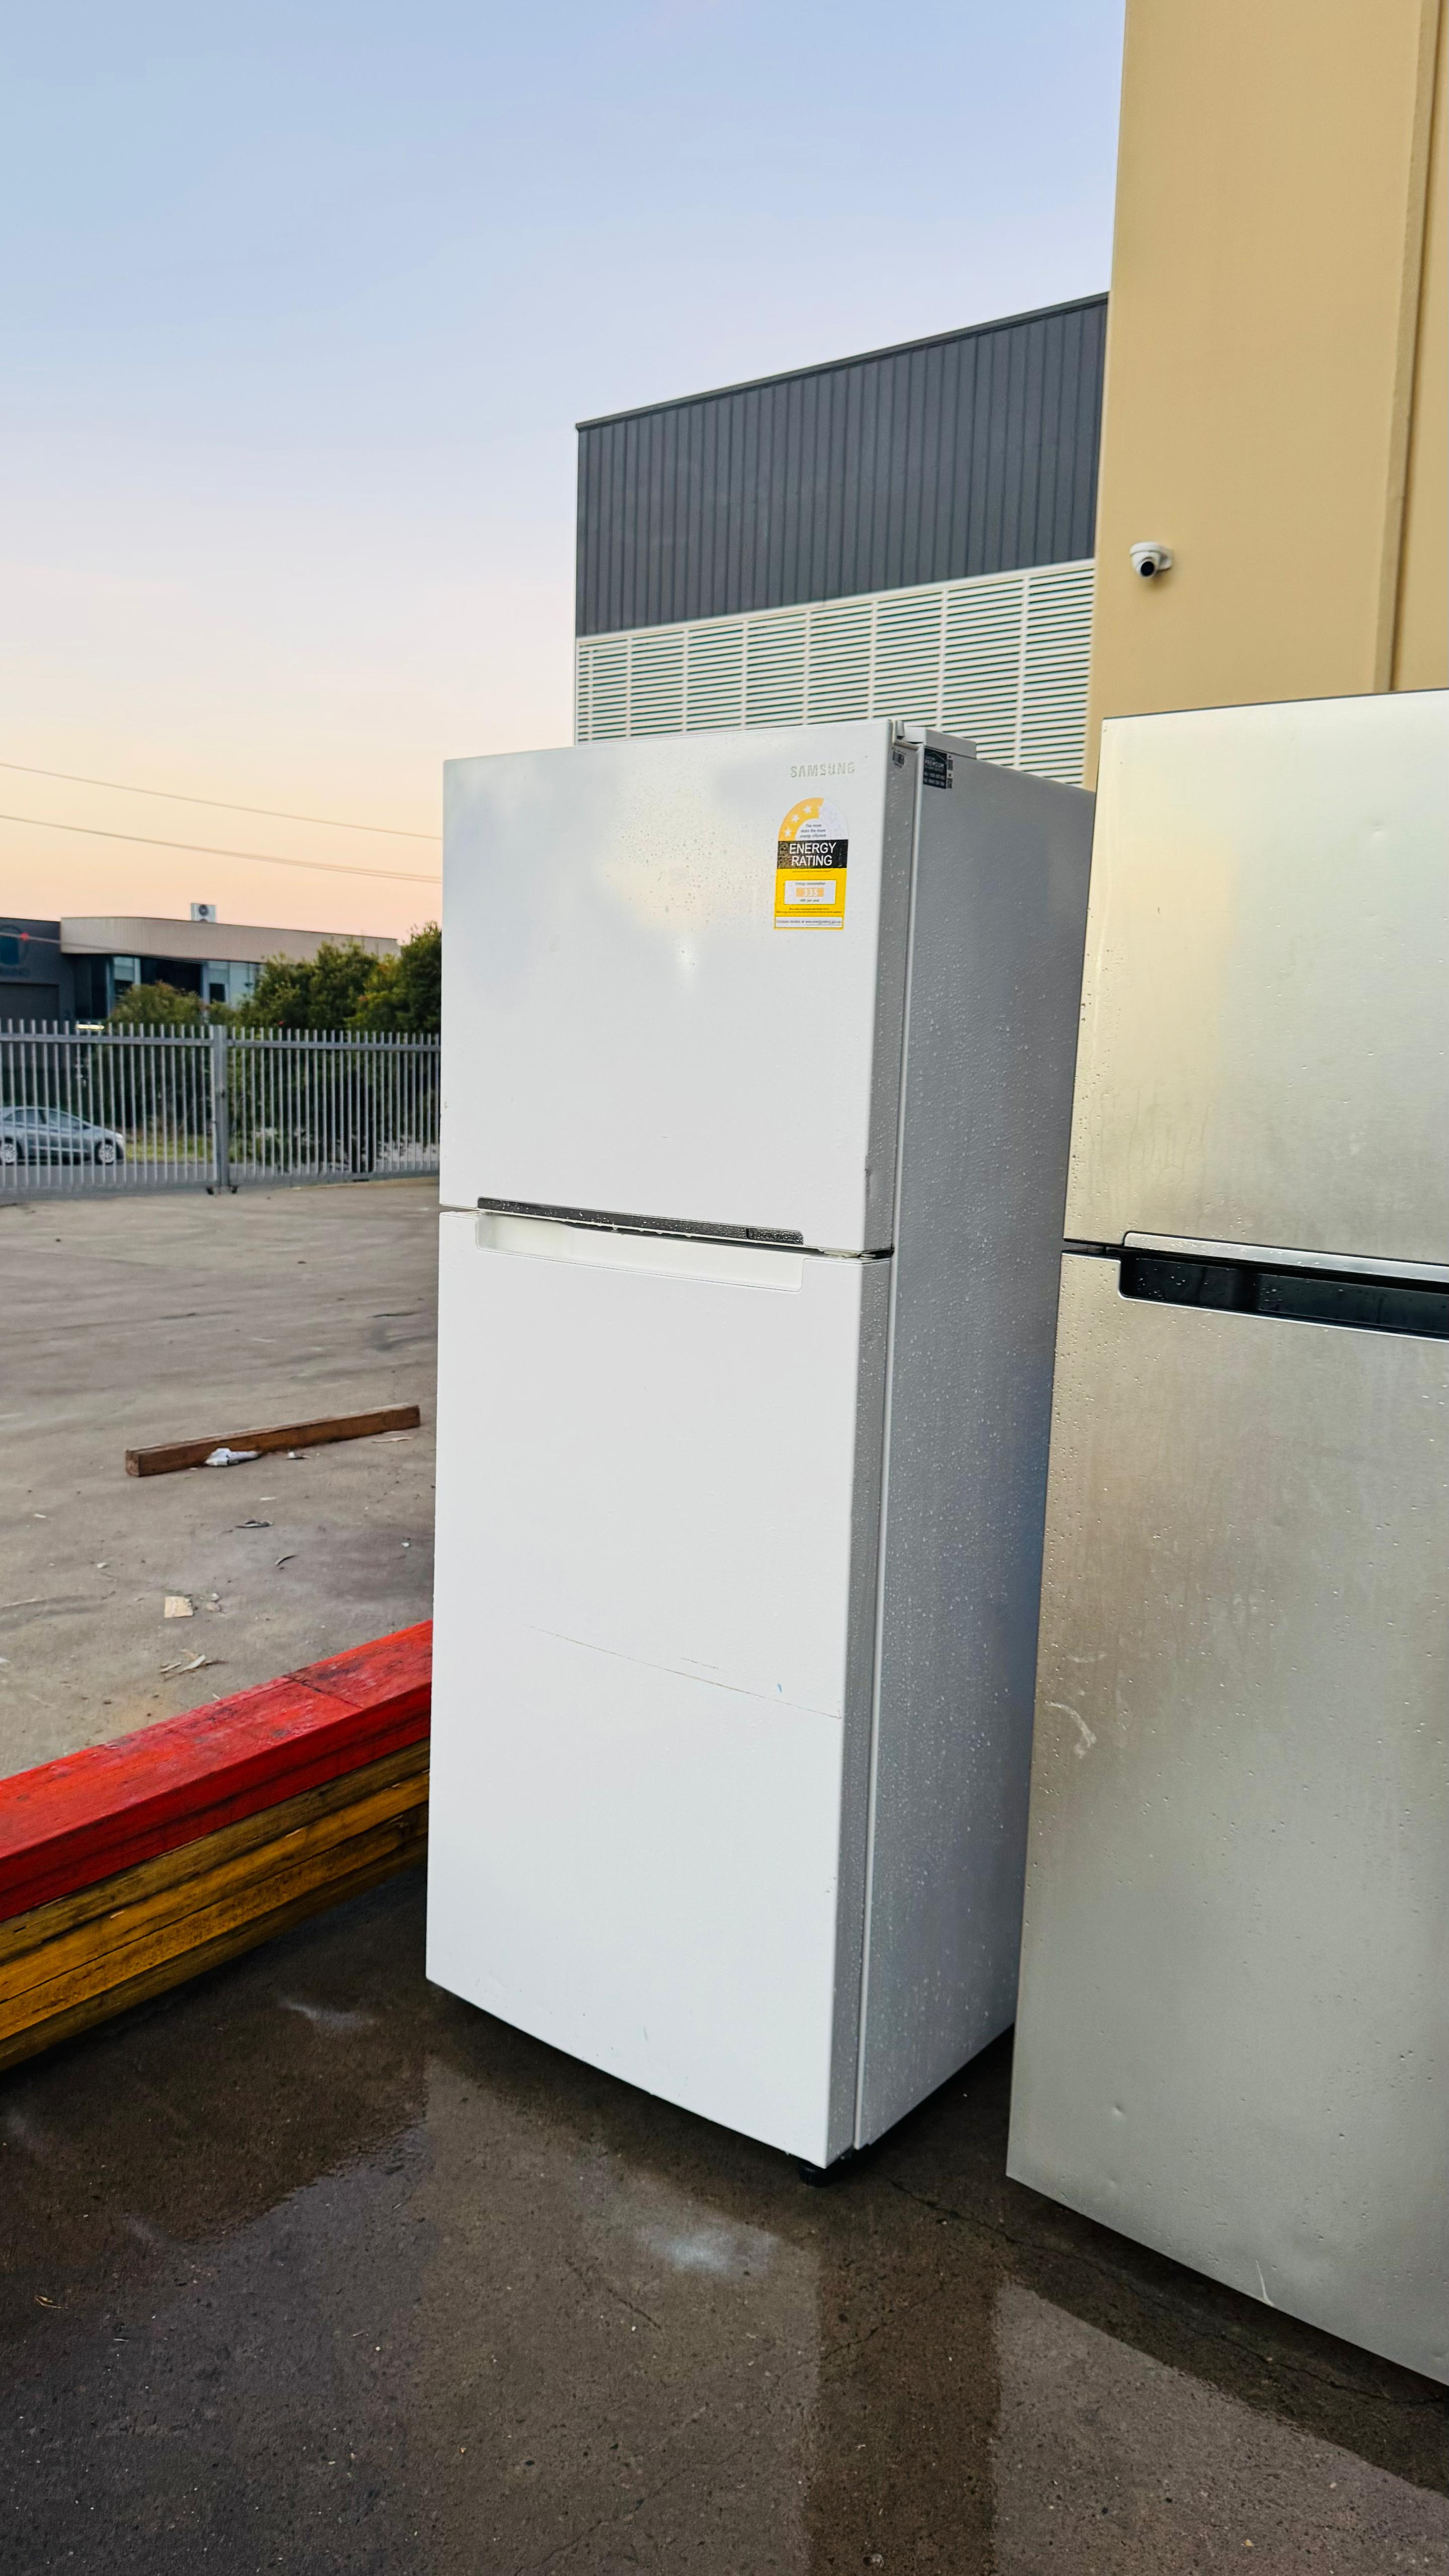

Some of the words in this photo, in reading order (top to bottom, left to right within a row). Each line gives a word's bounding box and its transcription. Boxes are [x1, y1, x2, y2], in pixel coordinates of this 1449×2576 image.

[790, 761, 855, 778] SAMSUNG
[789, 842, 837, 854] ENERGY
[791, 854, 833, 866] RATING
[803, 888, 819, 896] 335
